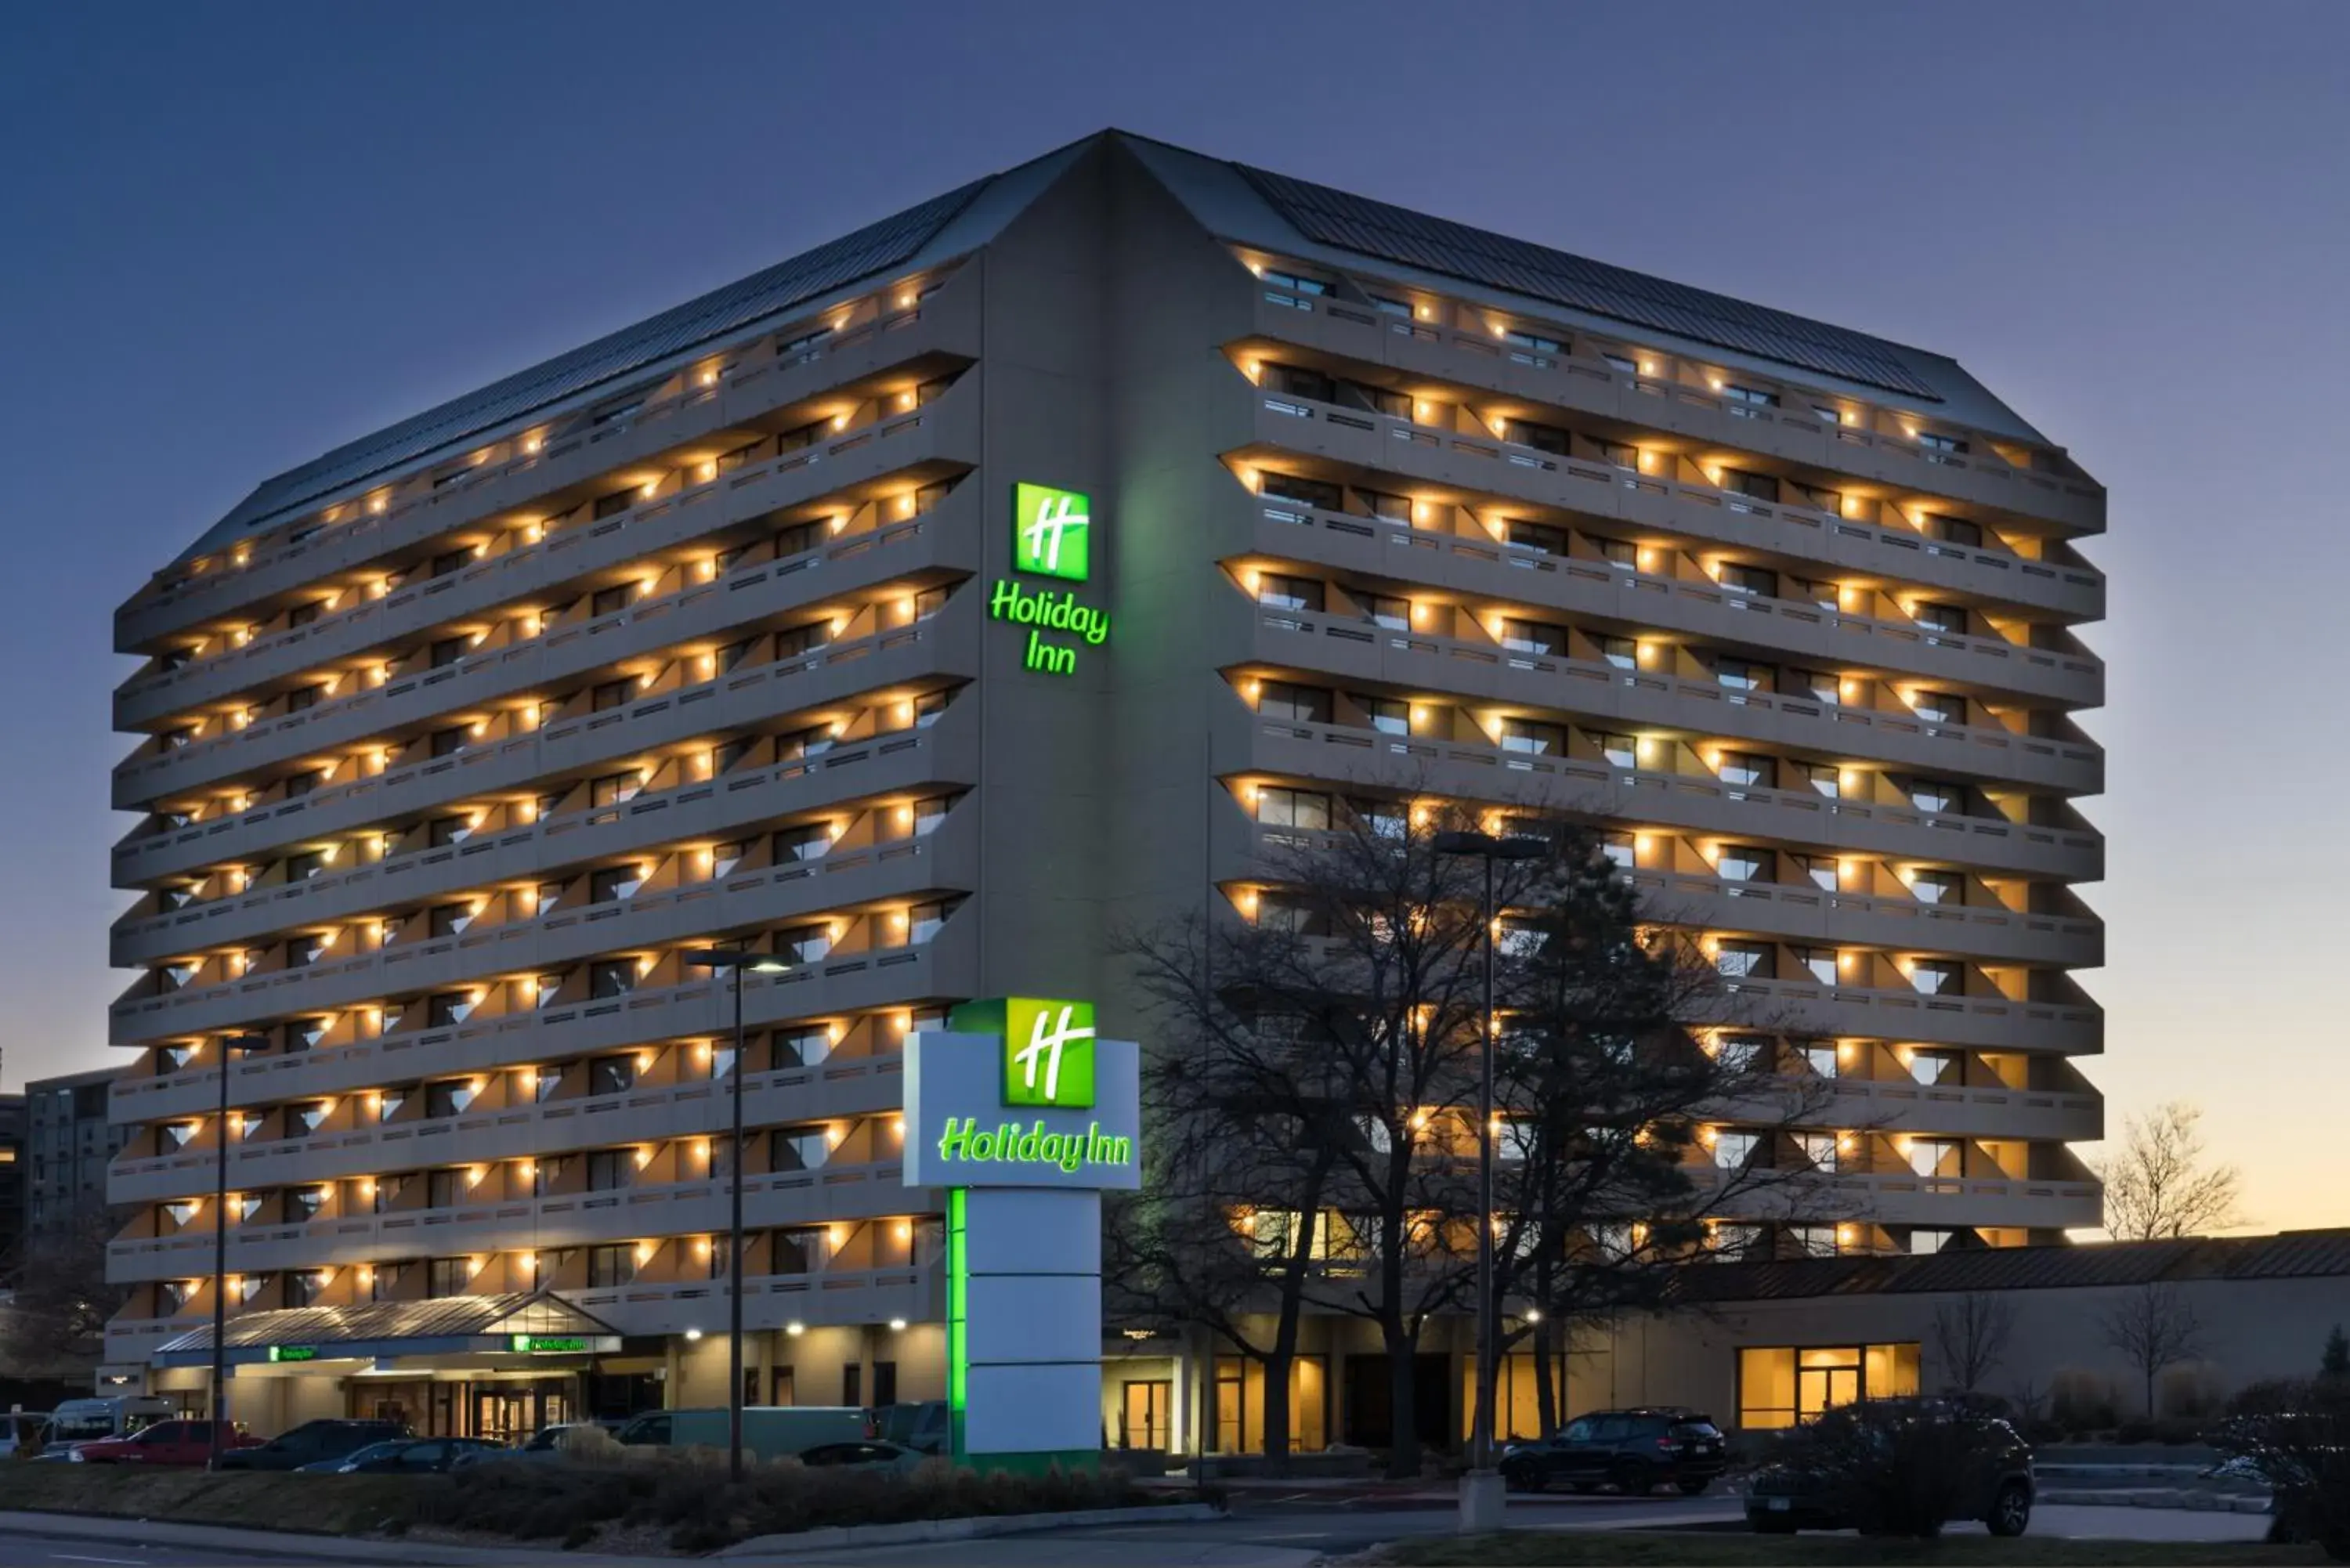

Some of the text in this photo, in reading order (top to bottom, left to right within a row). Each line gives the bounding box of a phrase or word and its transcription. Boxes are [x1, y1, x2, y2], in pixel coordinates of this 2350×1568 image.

[1023, 496, 1090, 570] H
[992, 580, 1108, 643] Holiday
[1027, 630, 1076, 674] Inn
[1014, 1006, 1095, 1100] H
[938, 1117, 1130, 1172] Holiday Inn
